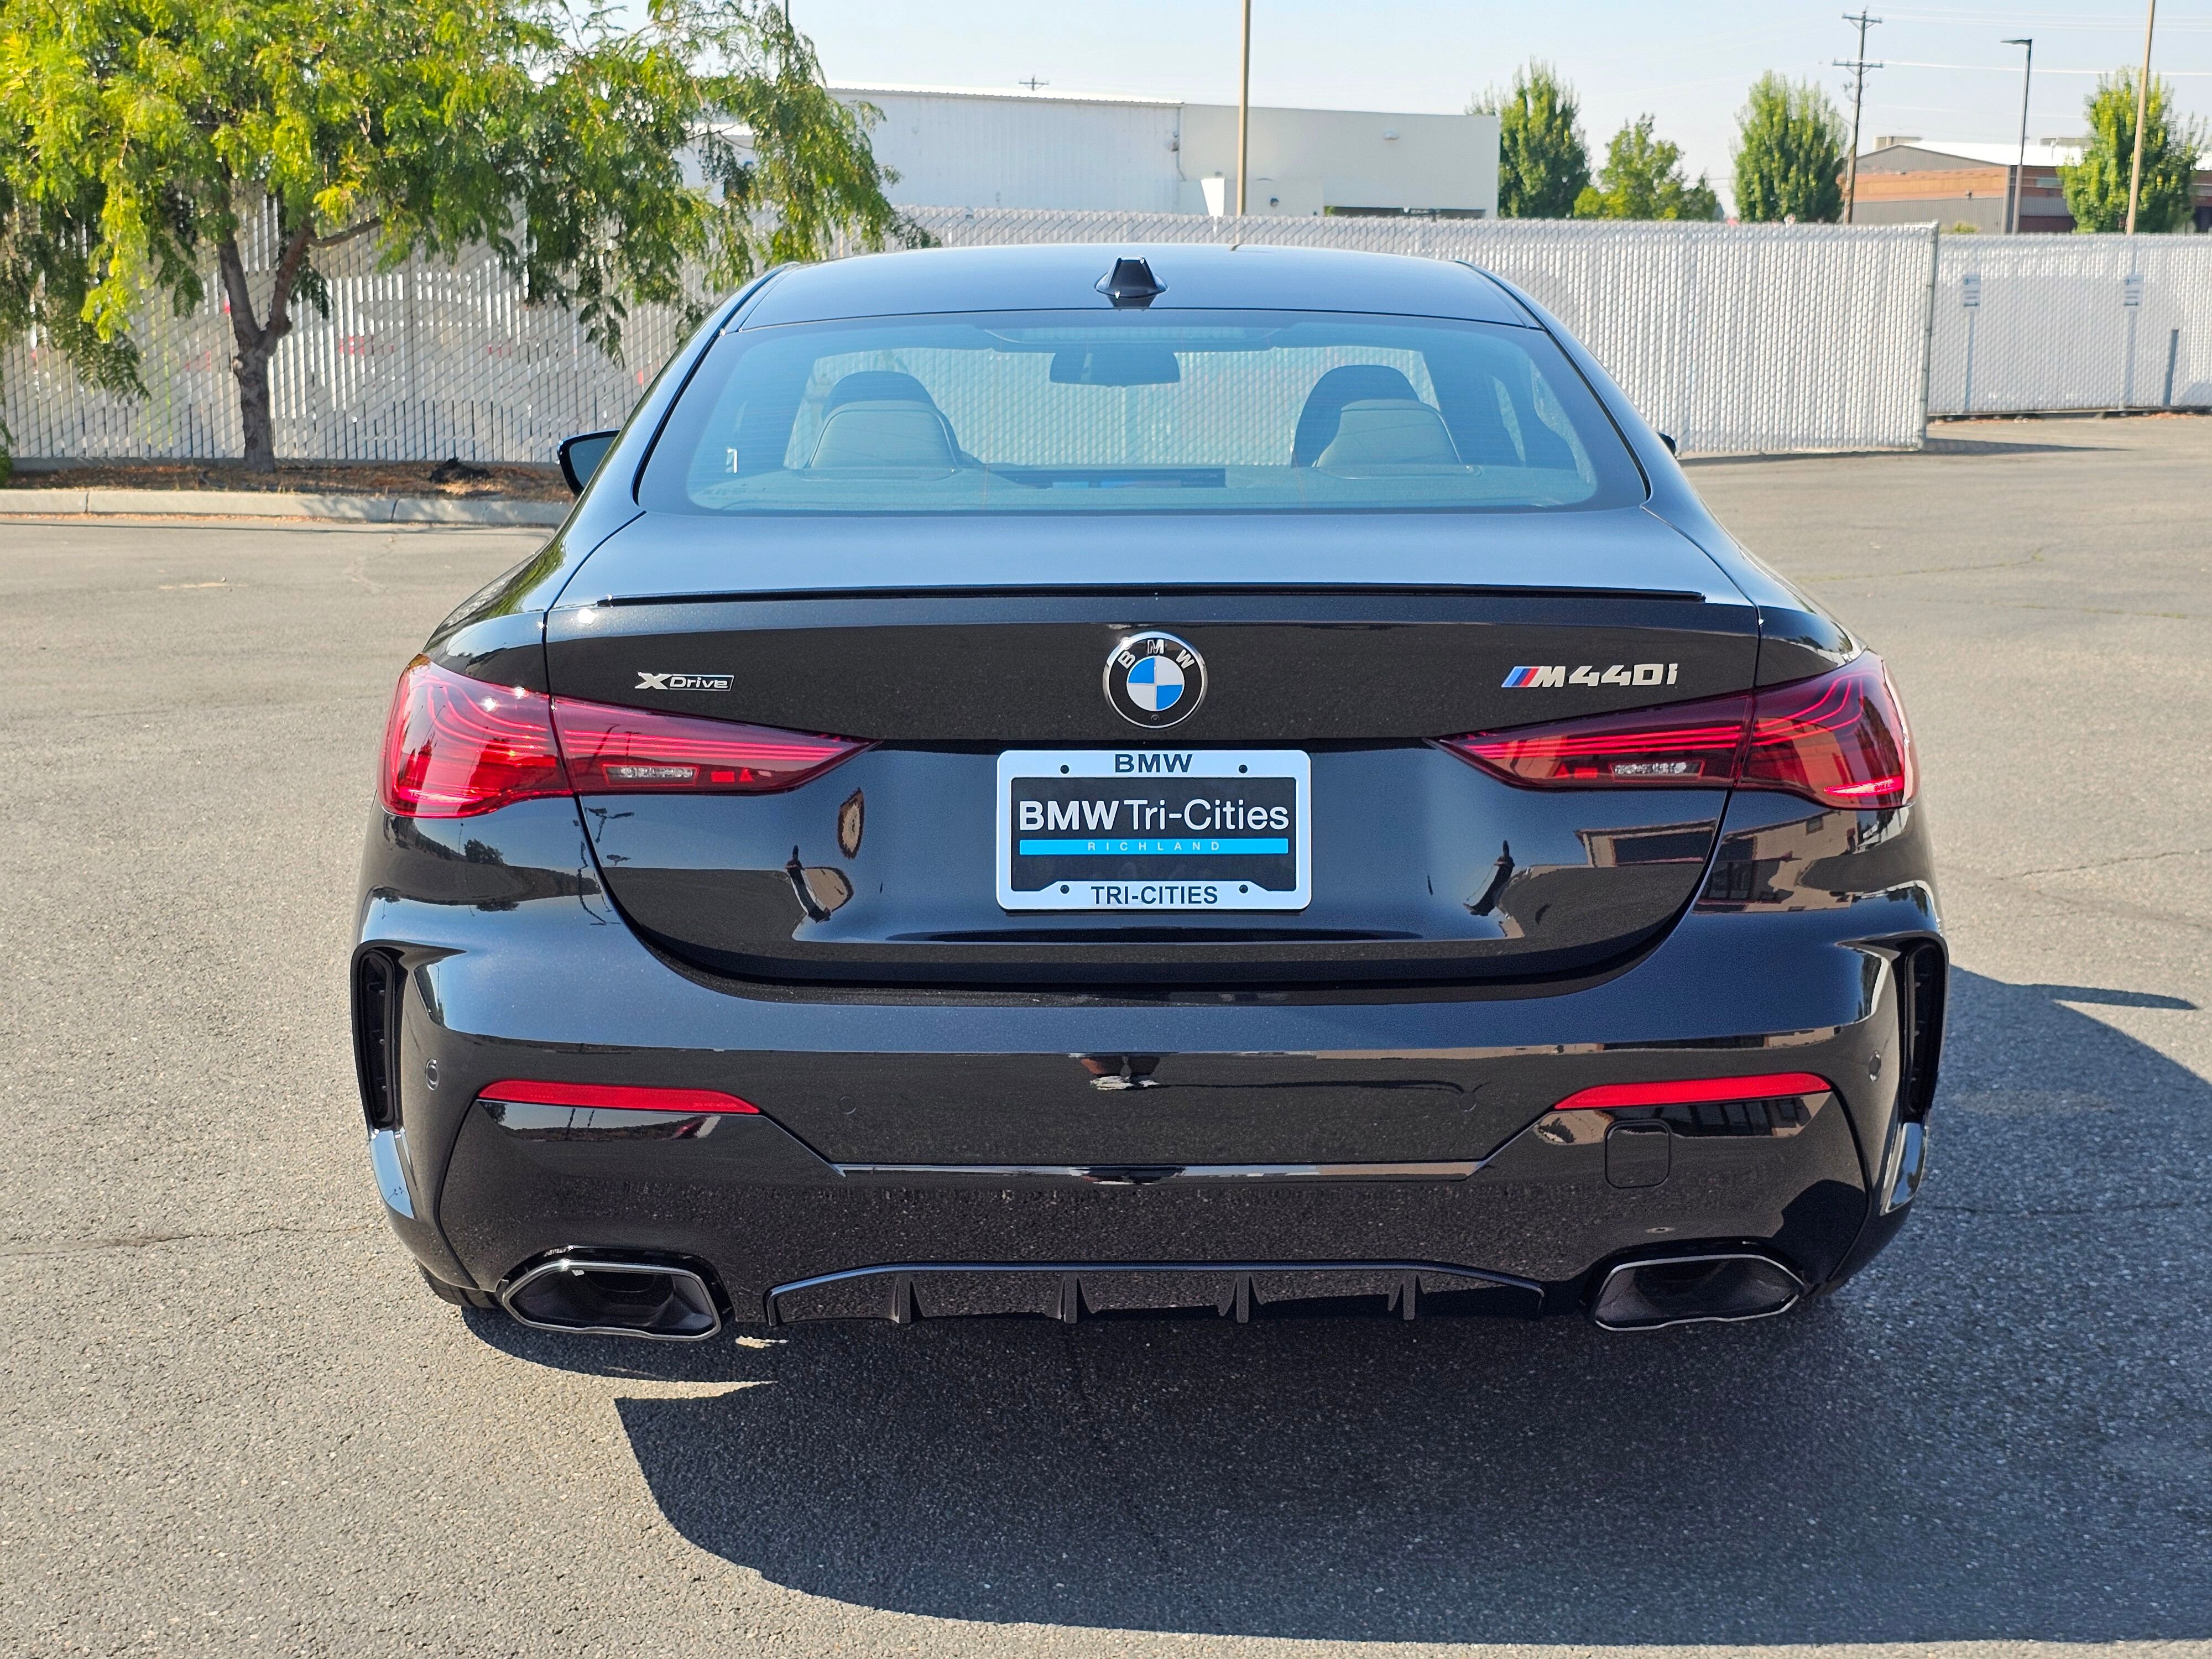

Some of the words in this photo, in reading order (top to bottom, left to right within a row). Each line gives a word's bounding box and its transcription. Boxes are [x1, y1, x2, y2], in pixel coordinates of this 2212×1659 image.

[1118, 639, 1194, 669] BMW
[1114, 754, 1193, 773] BMW
[1019, 800, 1119, 831] BMW
[1124, 799, 1290, 830] Tri-Cities
[1088, 842, 1220, 852] RICHLAND
[1091, 885, 1218, 905] TRI-CITIES
